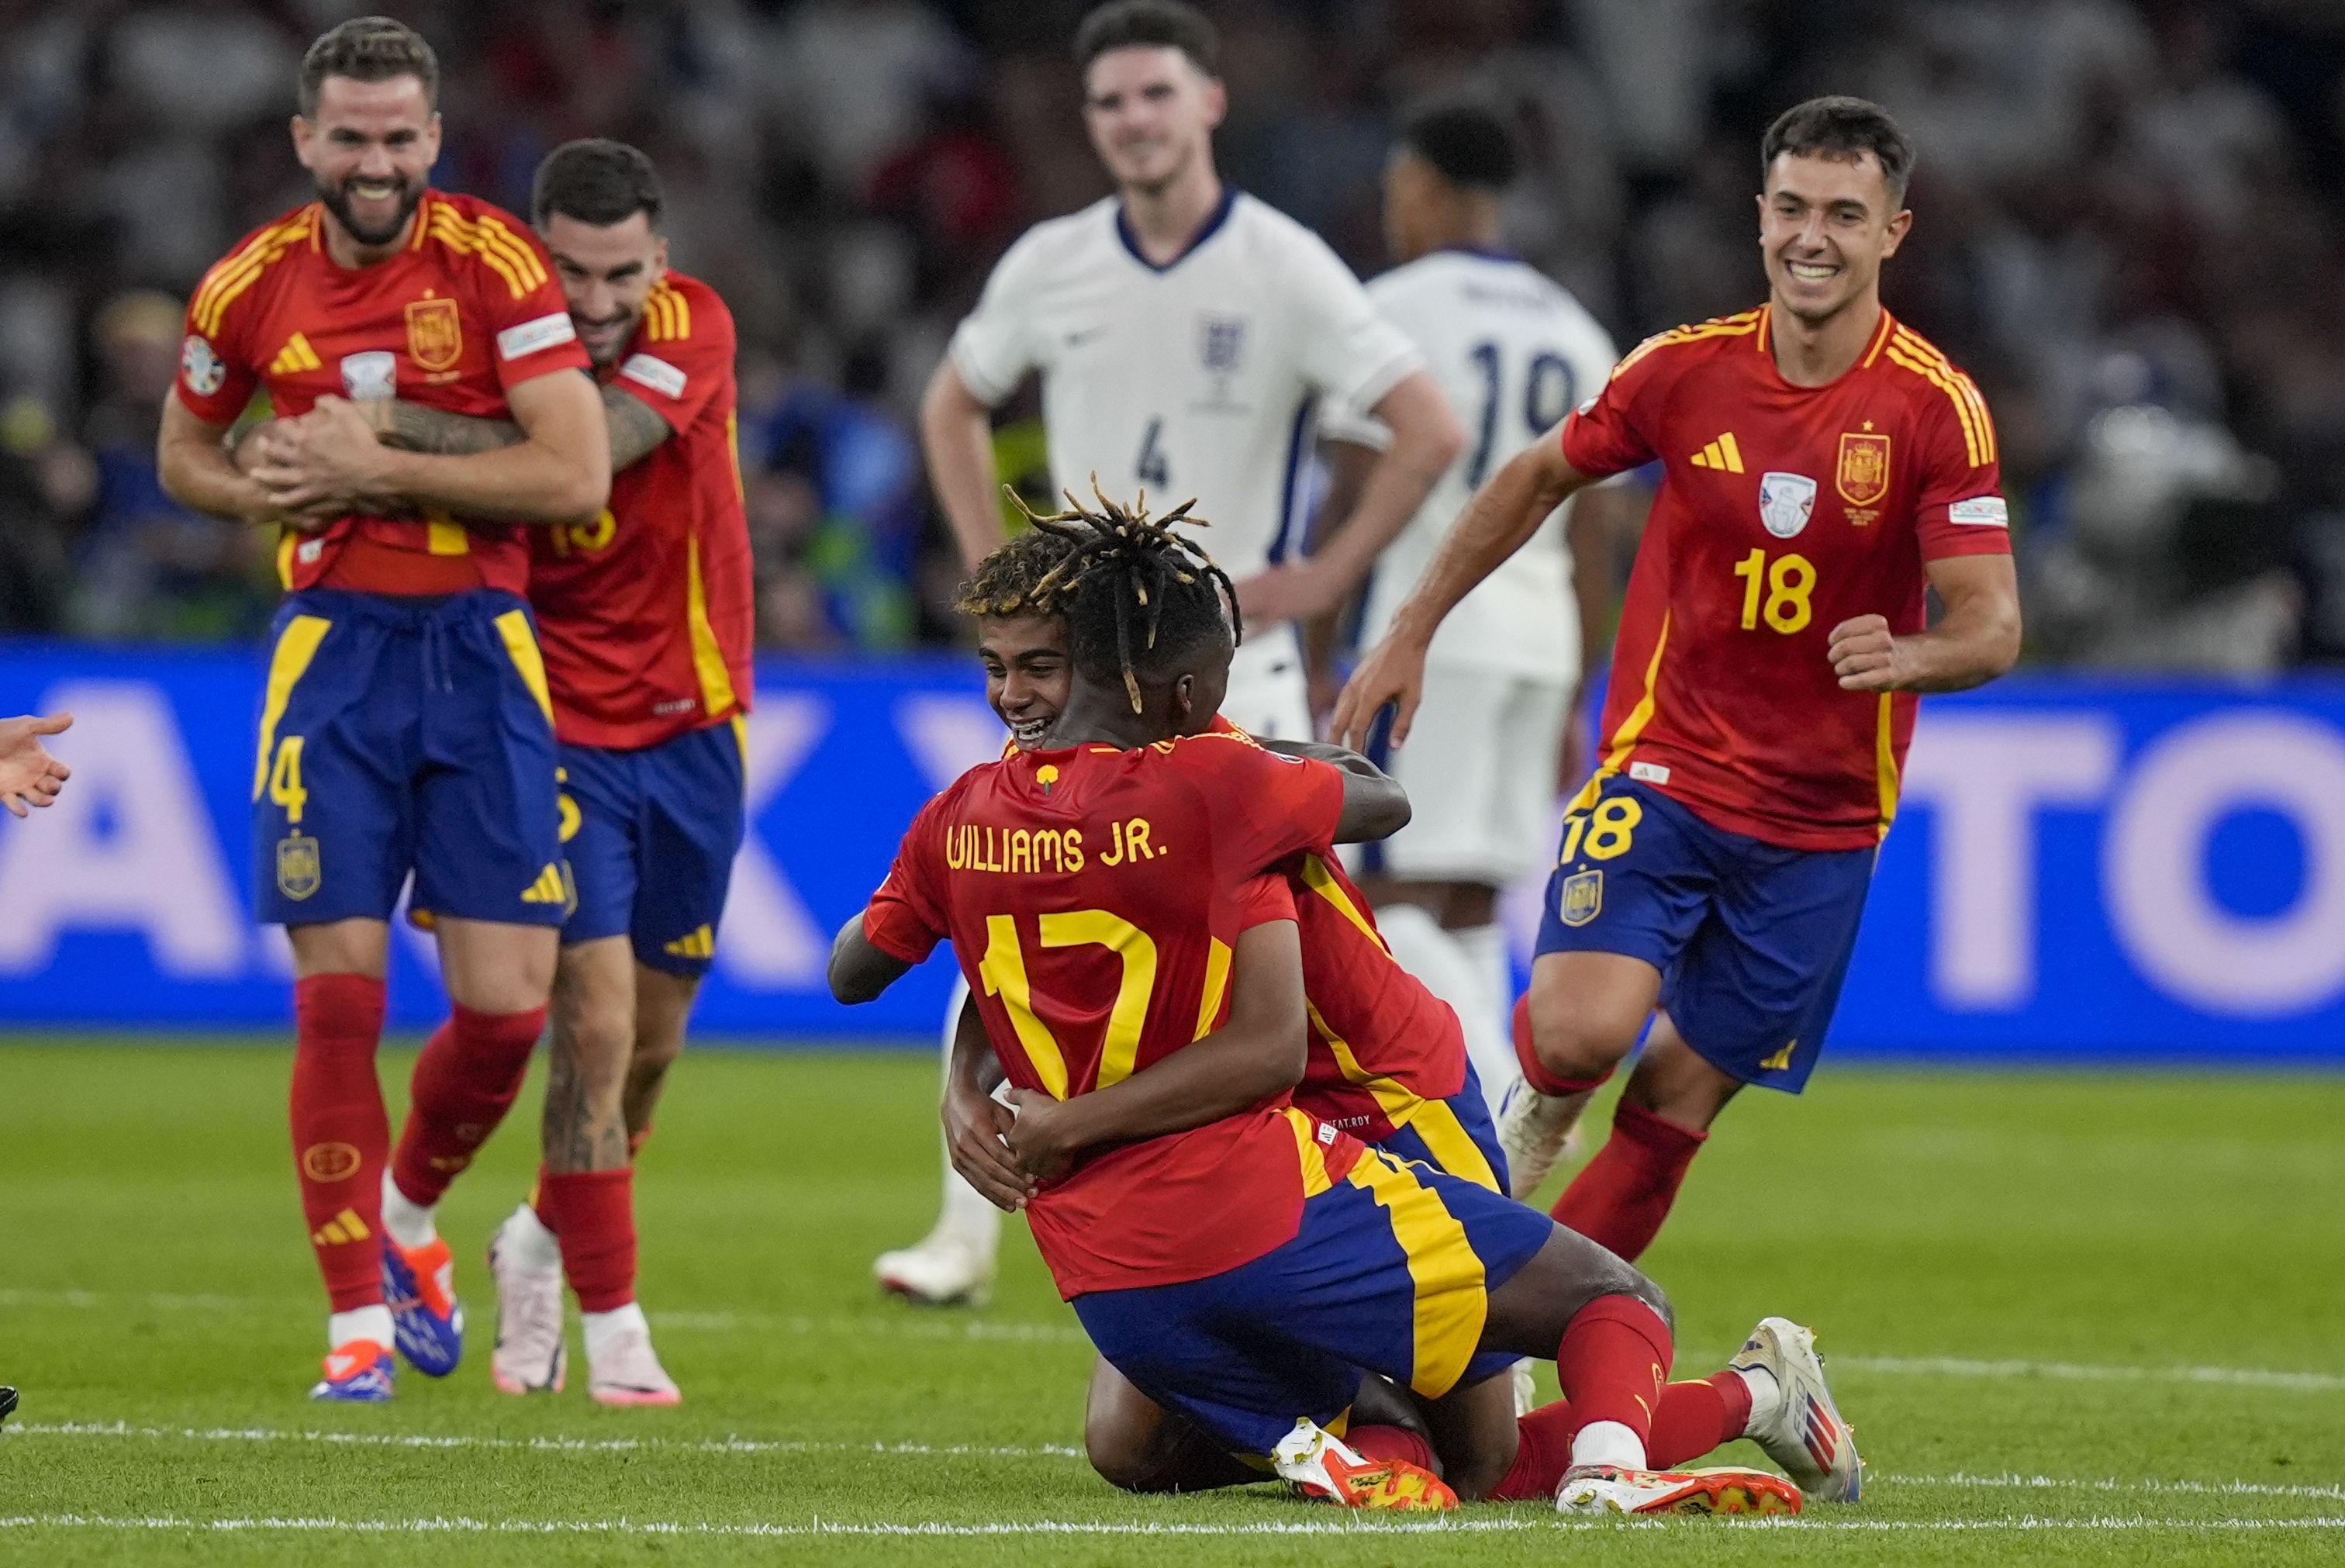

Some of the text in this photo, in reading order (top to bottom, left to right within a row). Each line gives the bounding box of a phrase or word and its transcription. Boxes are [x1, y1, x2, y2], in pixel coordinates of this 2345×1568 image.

[1136, 419, 1169, 491] 4
[1734, 547, 1817, 635] 18
[269, 735, 308, 824] 4
[945, 817, 1167, 873] WILLIAMS JR.
[1560, 796, 1642, 865] 18
[978, 909, 1158, 1102] 17
